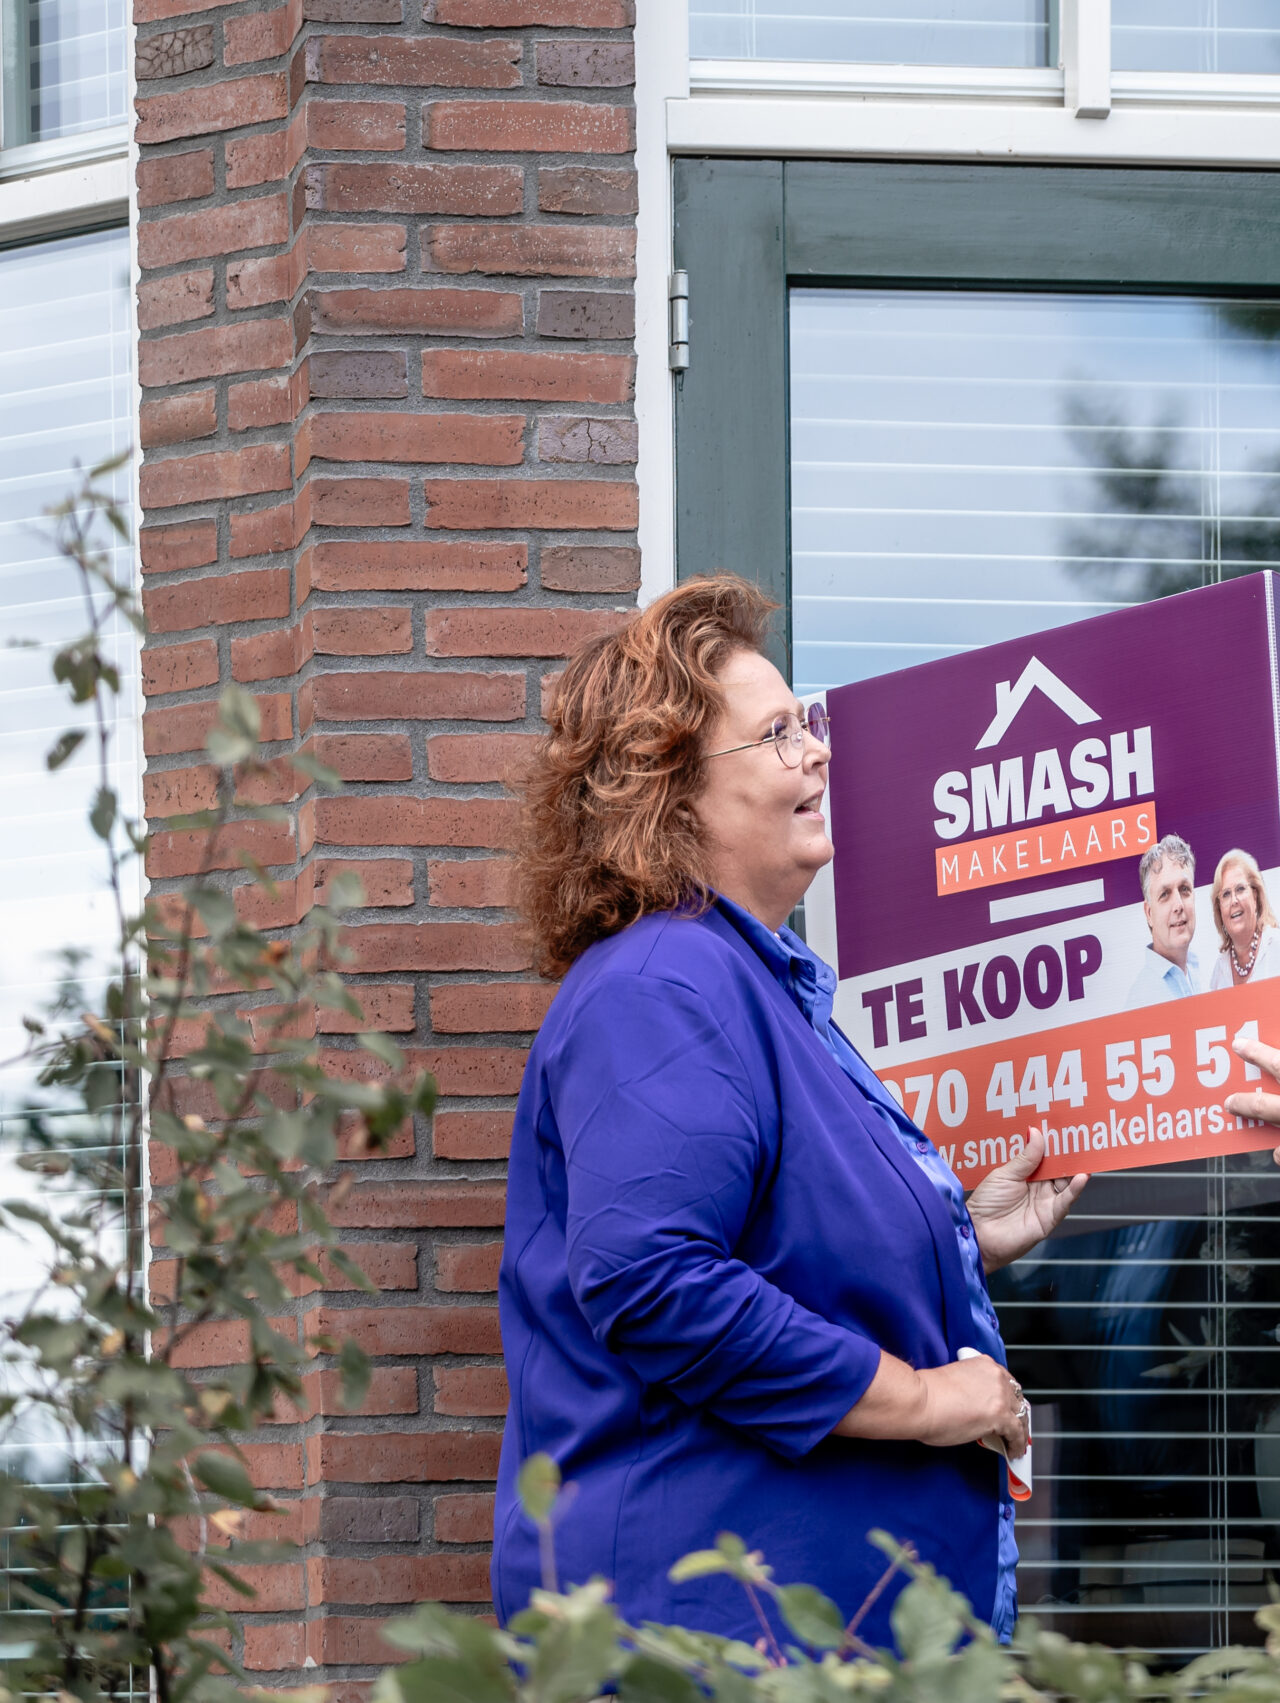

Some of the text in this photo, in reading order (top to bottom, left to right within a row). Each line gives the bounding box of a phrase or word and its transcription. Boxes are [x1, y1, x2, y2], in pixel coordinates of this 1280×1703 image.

[933, 725, 1155, 840] SMASH
[941, 813, 1151, 886] MAKELAARS
[861, 934, 1103, 1049] TE KOOP
[882, 1020, 1262, 1131] 70 444 55 51
